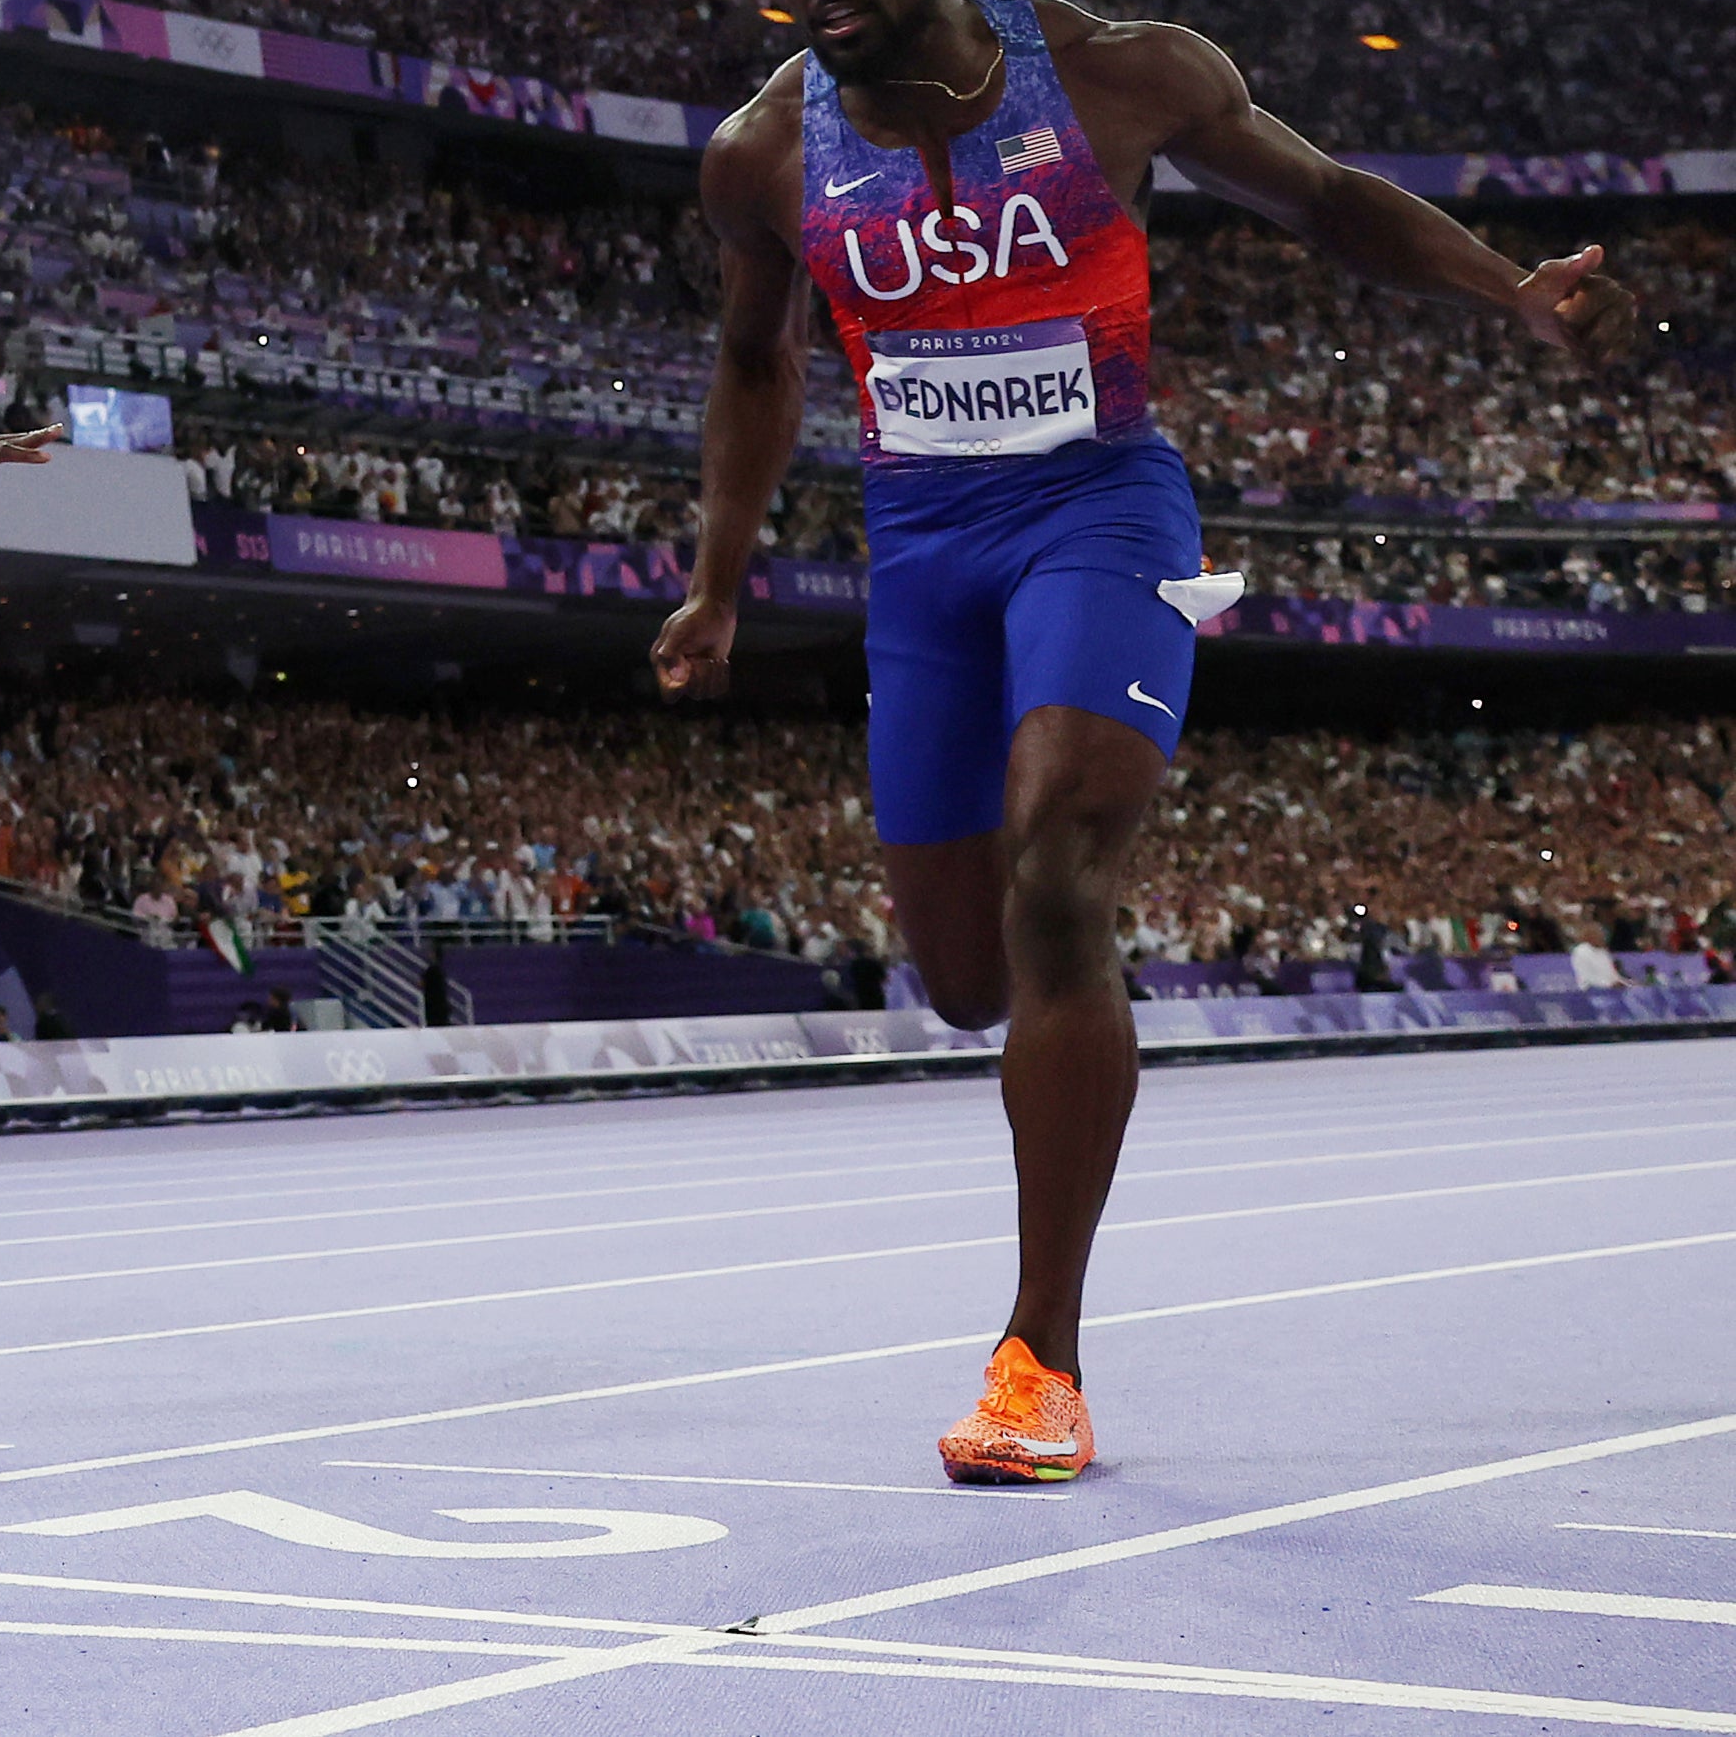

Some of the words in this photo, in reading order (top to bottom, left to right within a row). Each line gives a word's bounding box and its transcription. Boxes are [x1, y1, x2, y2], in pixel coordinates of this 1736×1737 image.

[844, 193, 1069, 301] USA
[910, 337, 964, 350] PARIS
[971, 333, 1023, 348] 2024
[874, 368, 1088, 421] BEDNAREK
